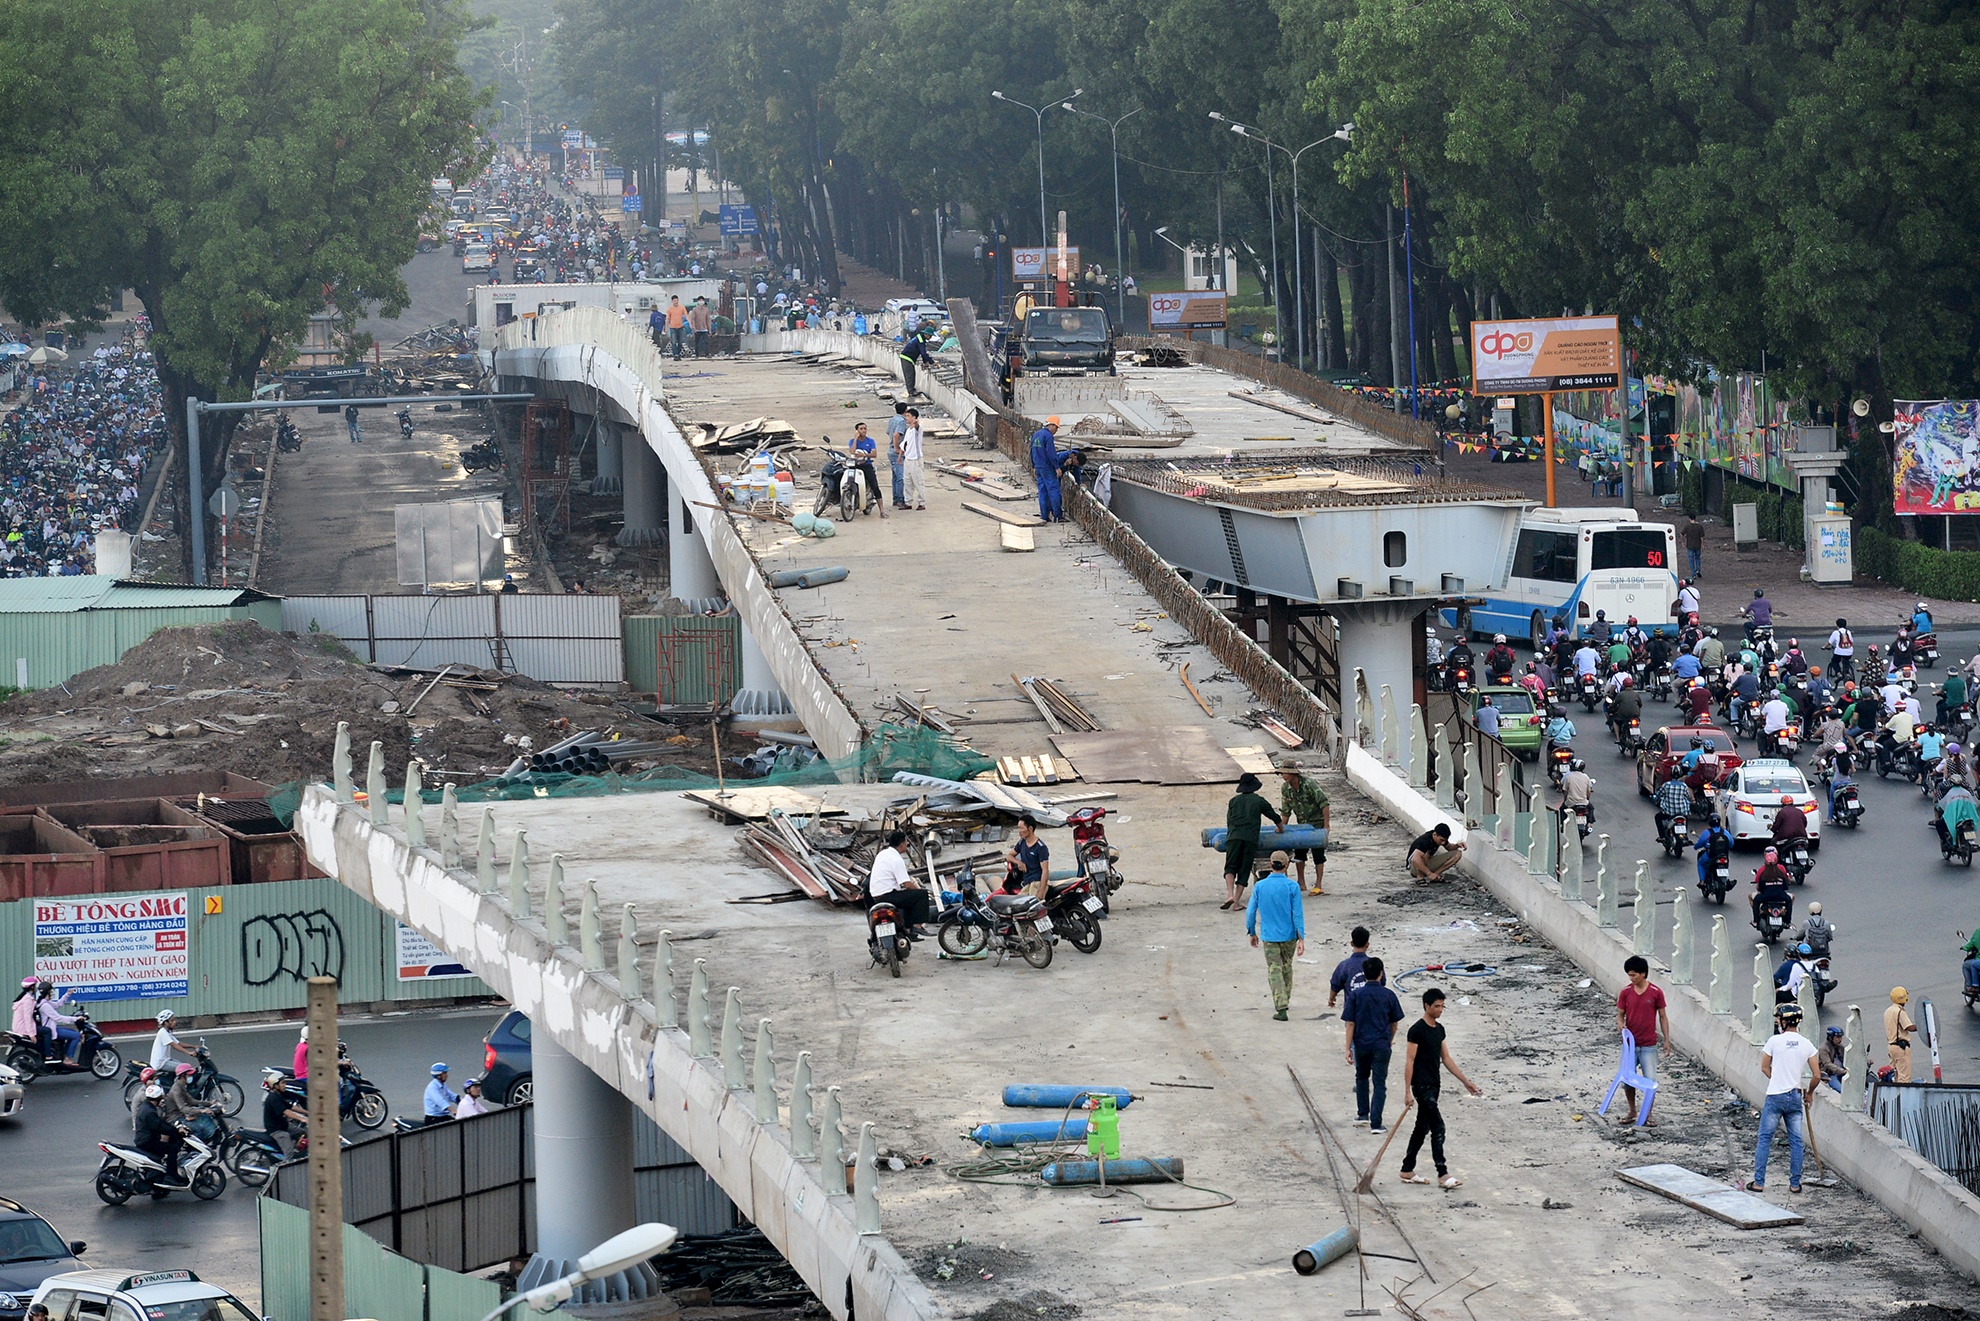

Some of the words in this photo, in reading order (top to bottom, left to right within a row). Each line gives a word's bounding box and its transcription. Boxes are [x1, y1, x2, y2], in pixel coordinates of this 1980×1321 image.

[1559, 378, 1573, 386] (08)
[1595, 376, 1612, 384] 1111
[1647, 552, 1662, 566] 50
[36, 902, 66, 922] BÊ
[71, 901, 136, 921] TÔNG
[38, 926, 74, 934] THƯƠNG
[76, 924, 96, 934] HIỆU
[99, 923, 110, 932] BÊ
[113, 922, 137, 931] TÔNG
[140, 920, 164, 929] HÀNG
[166, 918, 184, 928] ĐẦU
[36, 959, 57, 971] CẦU
[60, 960, 88, 971] VƯỢT
[91, 957, 116, 968] THÉP
[119, 958, 135, 968] TẠI
[137, 955, 158, 966] NÚT
[160, 954, 186, 965] GIAO
[98, 971, 118, 981] SƠN
[126, 968, 163, 979] NGUYỄN
[165, 967, 186, 977] KIỆM
[72, 986, 96, 994] OTLINE:
[144, 1273, 174, 1282] VINASUN
